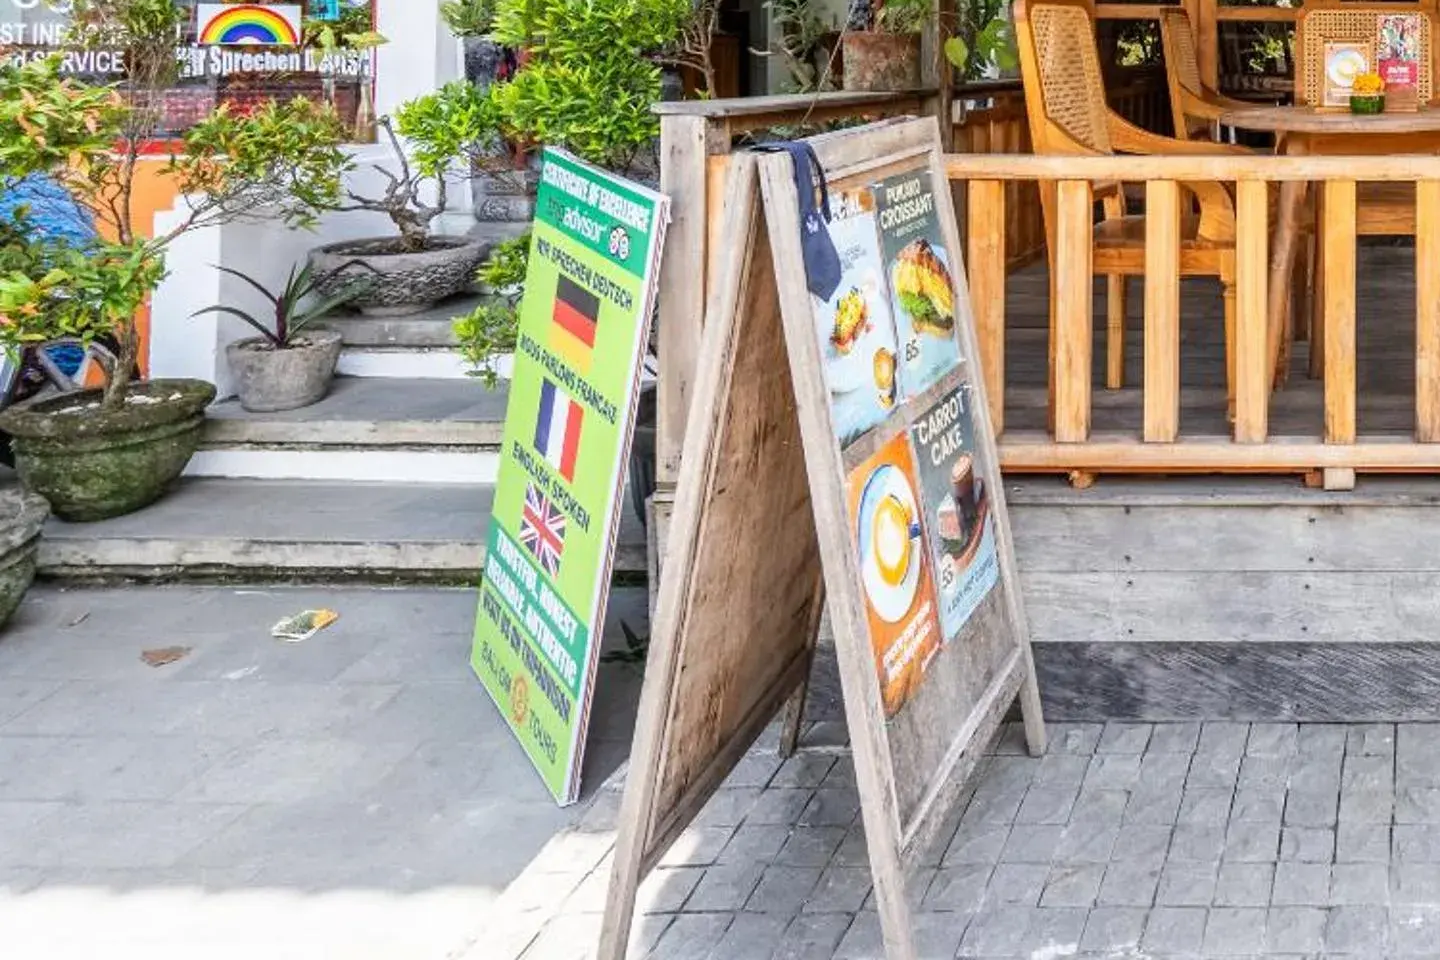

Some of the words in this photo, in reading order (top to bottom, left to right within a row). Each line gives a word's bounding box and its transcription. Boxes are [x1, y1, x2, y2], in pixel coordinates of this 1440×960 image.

[209, 46, 300, 77] Sprechen
[918, 391, 965, 445] CARROT
[930, 422, 963, 467] CAKE
[551, 478, 591, 533] SPOKEN
